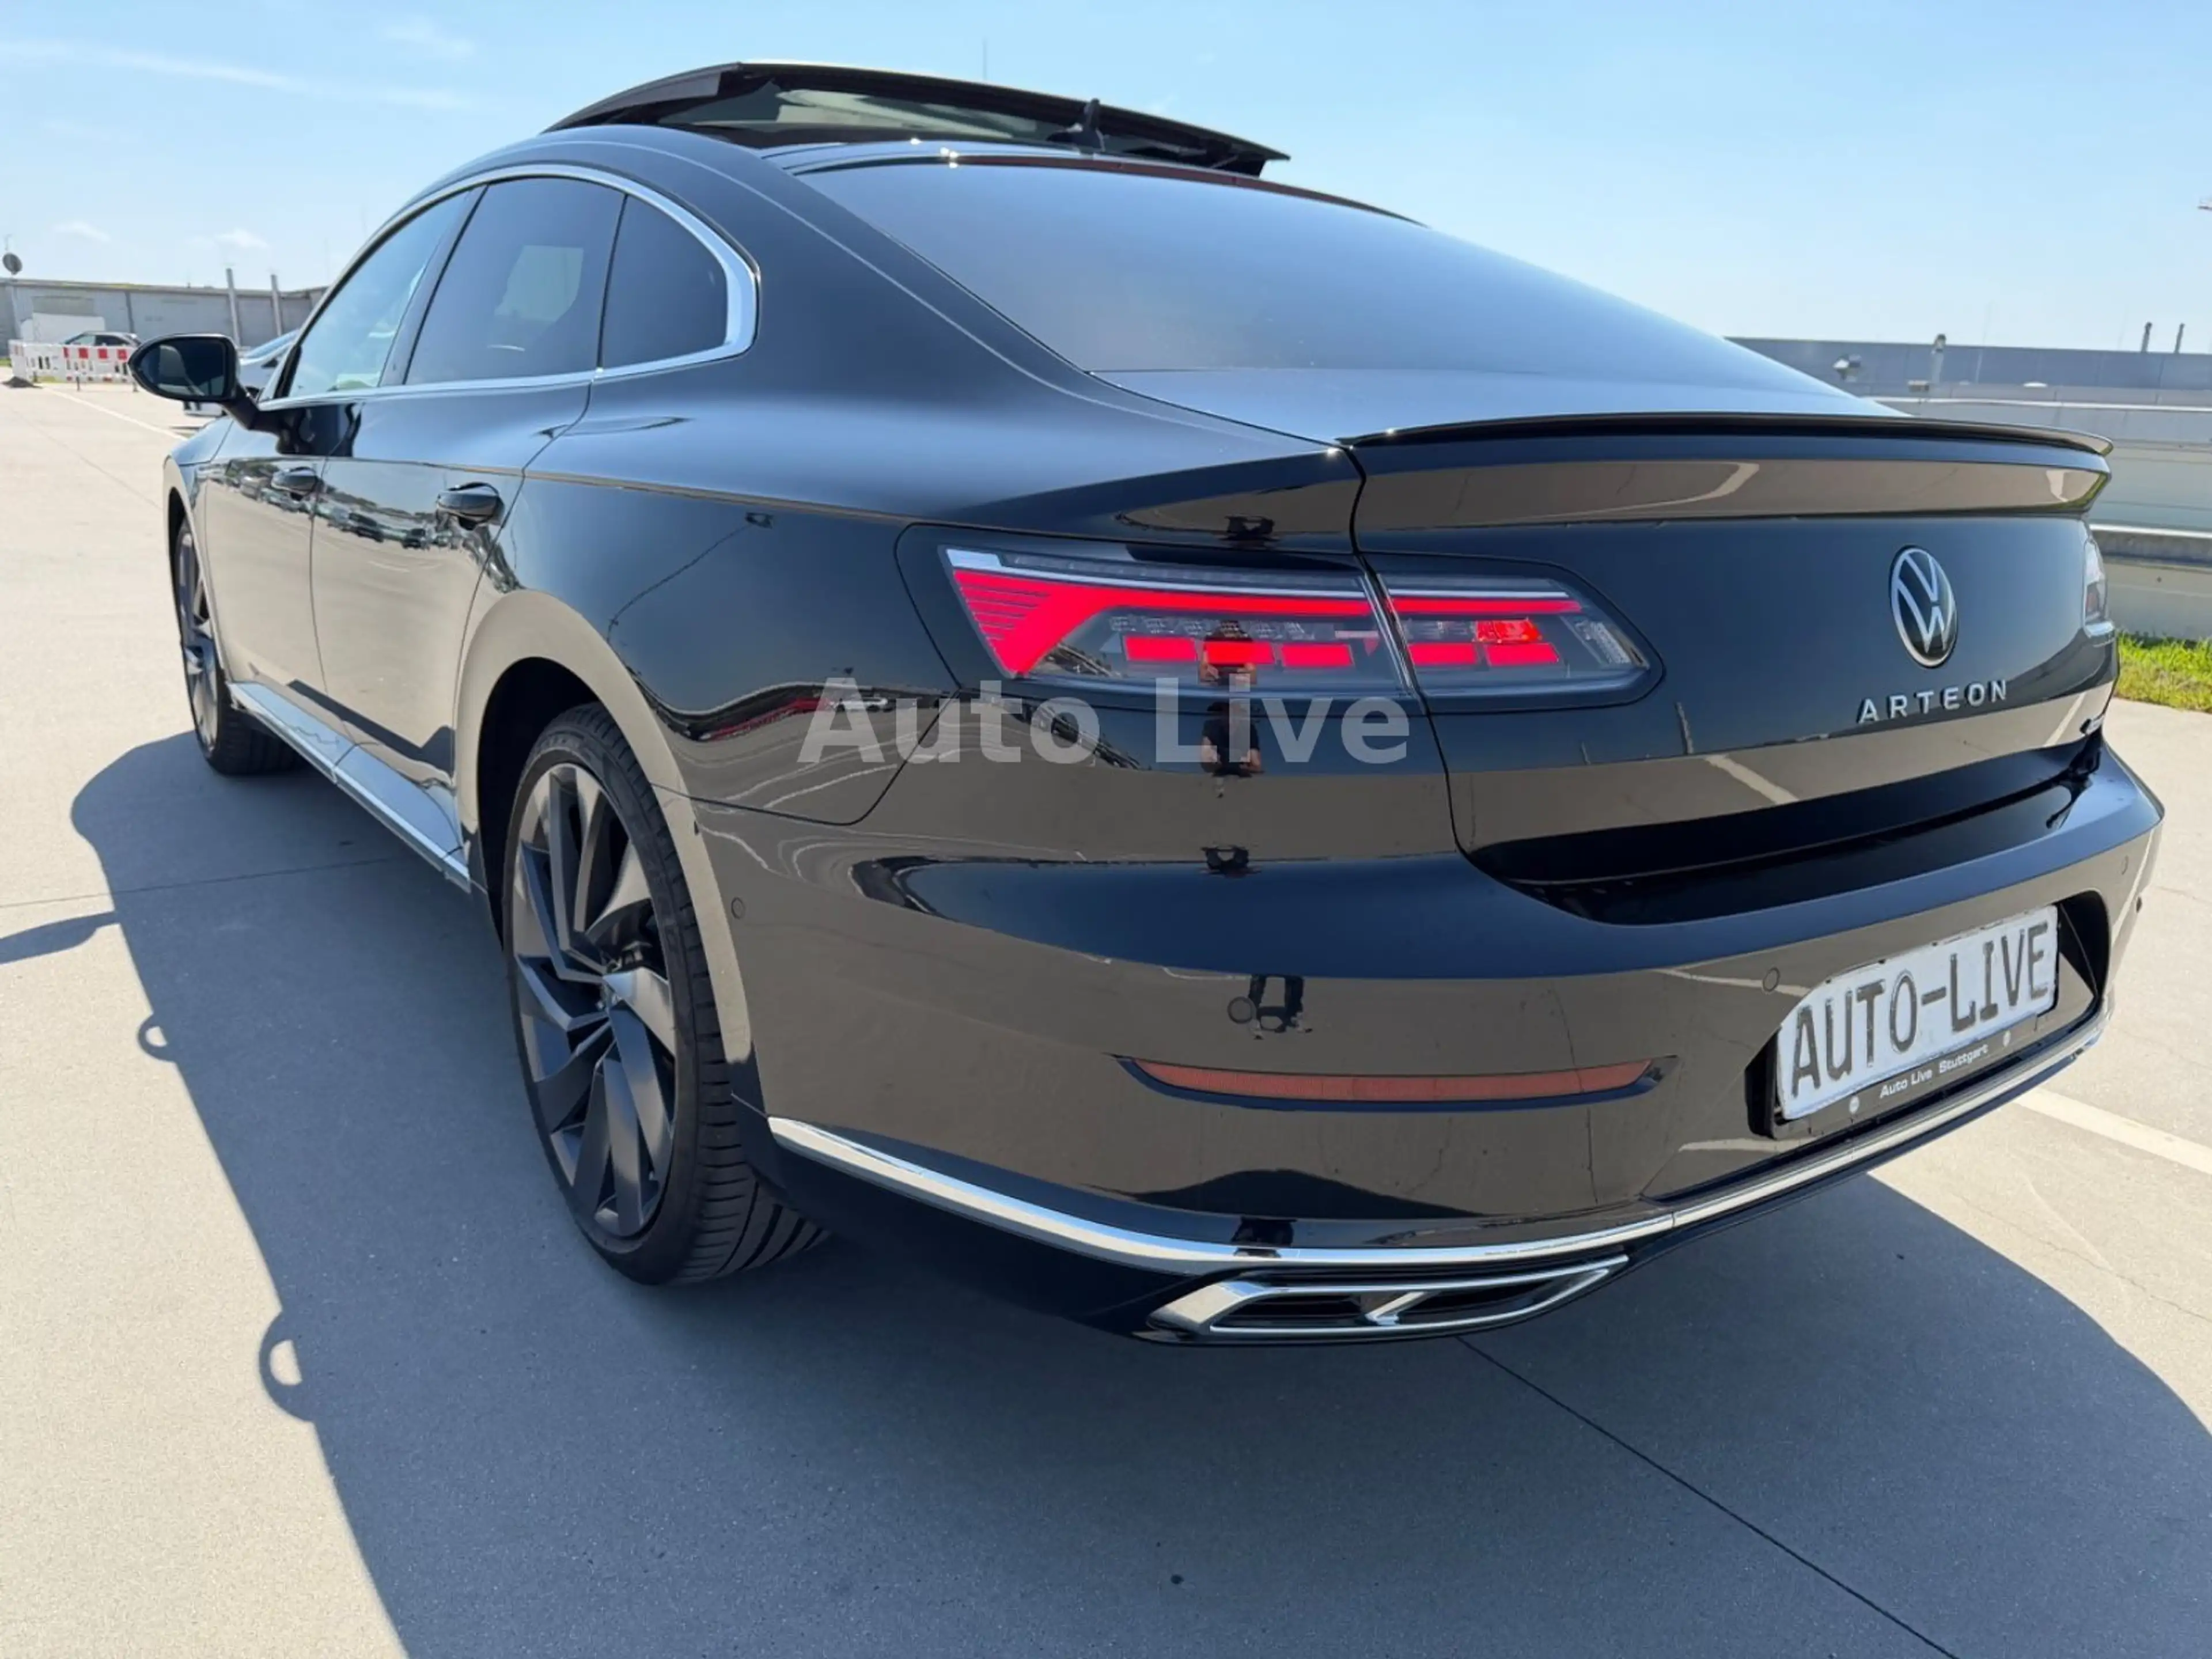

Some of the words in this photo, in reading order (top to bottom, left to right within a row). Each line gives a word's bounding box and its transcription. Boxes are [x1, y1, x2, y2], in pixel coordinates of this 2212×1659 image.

[1892, 547, 1957, 667] VW
[1858, 680, 2007, 724] ARTEON
[1791, 922, 2048, 1097] AUTO-LIVE
[1880, 1079, 1908, 1098] Auto
[1911, 1069, 1933, 1085] Live
[1939, 1044, 1989, 1074] Stuttgart
